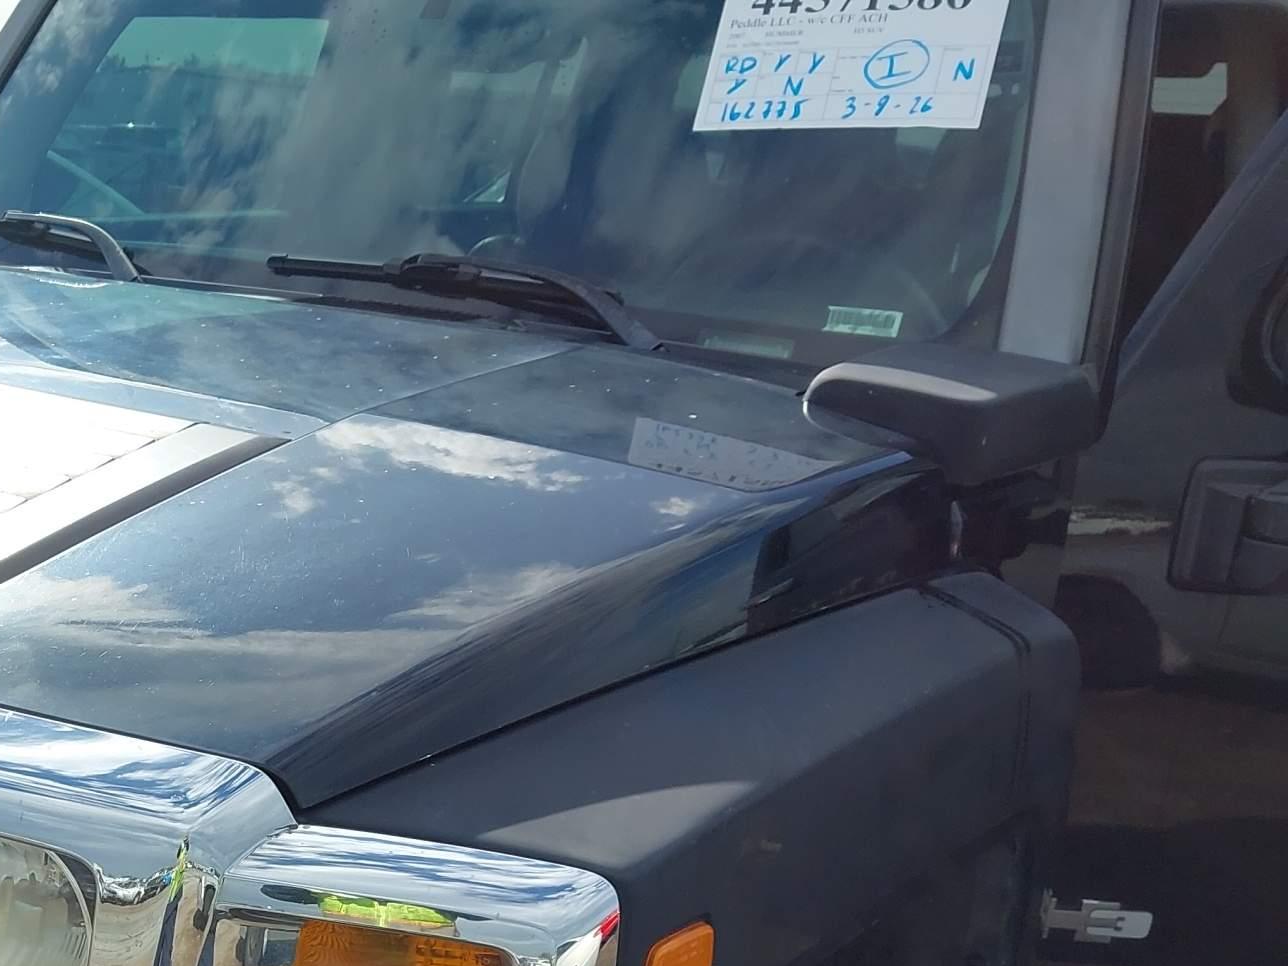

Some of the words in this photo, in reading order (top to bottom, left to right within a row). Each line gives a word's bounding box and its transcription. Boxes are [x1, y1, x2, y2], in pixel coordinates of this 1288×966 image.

[730, 16, 768, 29] Peddle
[770, 15, 797, 27] LLC
[952, 58, 975, 81] N
[783, 76, 804, 96] N
